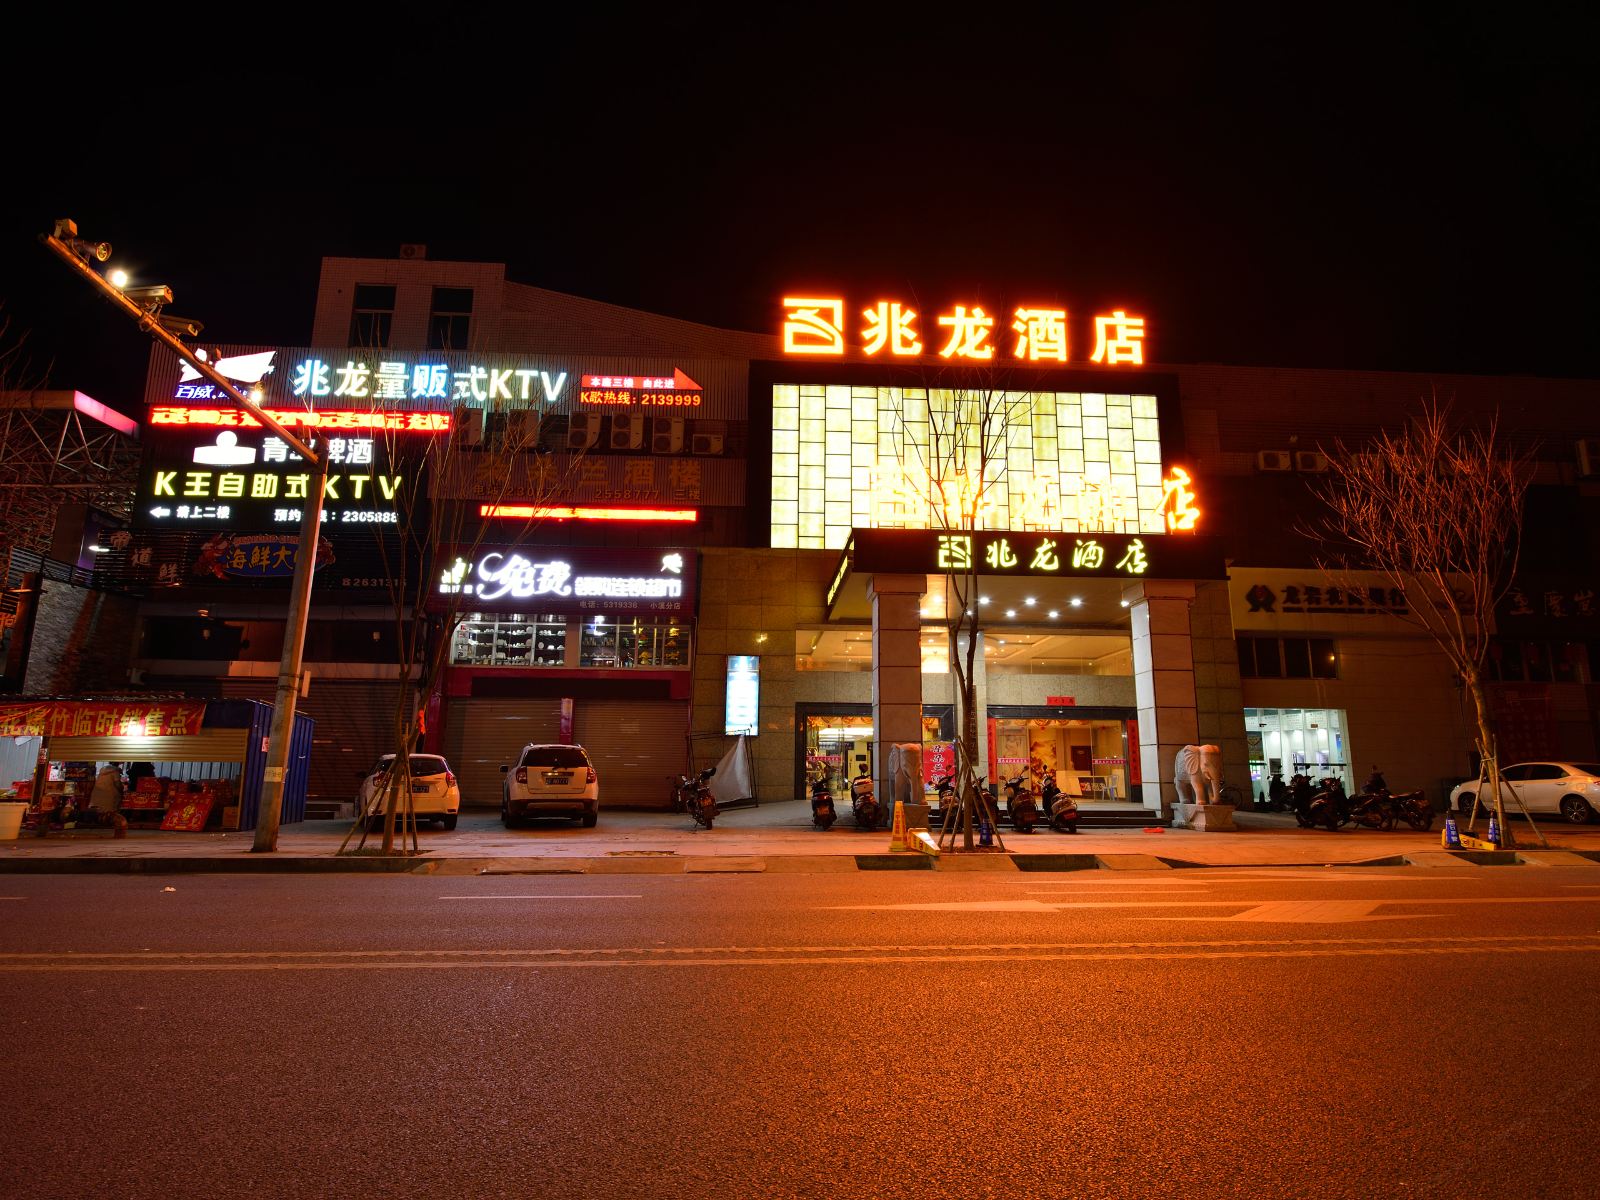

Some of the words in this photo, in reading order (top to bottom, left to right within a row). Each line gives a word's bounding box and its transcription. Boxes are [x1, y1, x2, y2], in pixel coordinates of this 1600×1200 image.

[861, 301, 1146, 364] 兆龙酒店
[293, 359, 567, 402] 兆龙量贩式KTV
[478, 552, 572, 600] 免费
[986, 538, 1149, 574] 兆龙酒店
